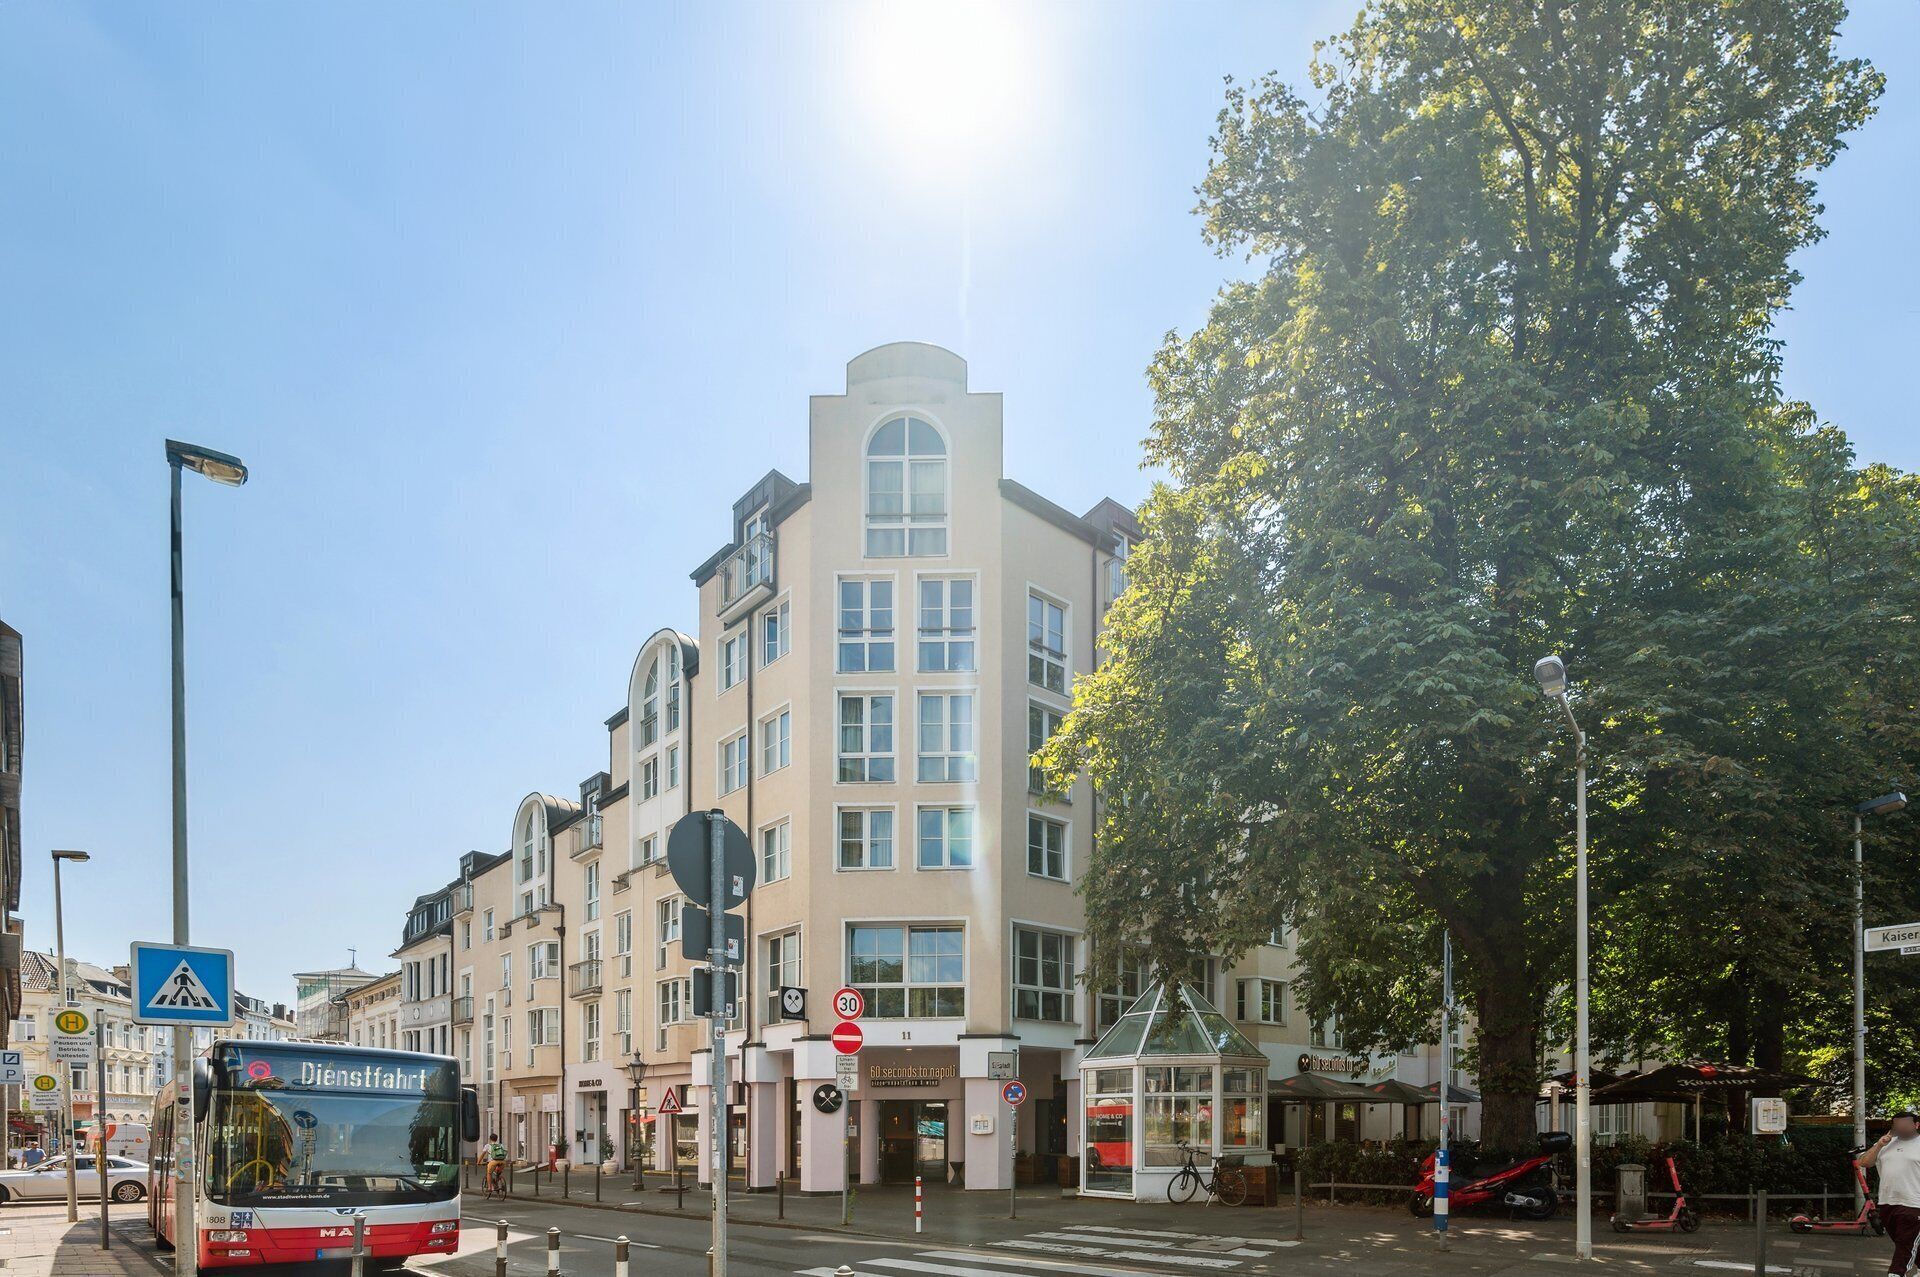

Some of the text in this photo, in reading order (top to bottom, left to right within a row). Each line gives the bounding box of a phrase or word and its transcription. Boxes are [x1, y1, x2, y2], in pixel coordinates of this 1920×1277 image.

[839, 997, 858, 1012] 30
[65, 1015, 79, 1029] H
[902, 1031, 912, 1040] 11
[6, 1069, 17, 1079] P
[301, 1062, 427, 1090] Dienstfahrt
[870, 1064, 956, 1080] 60 seconds to napoli
[40, 1078, 50, 1088] H
[205, 1216, 226, 1224] 1808
